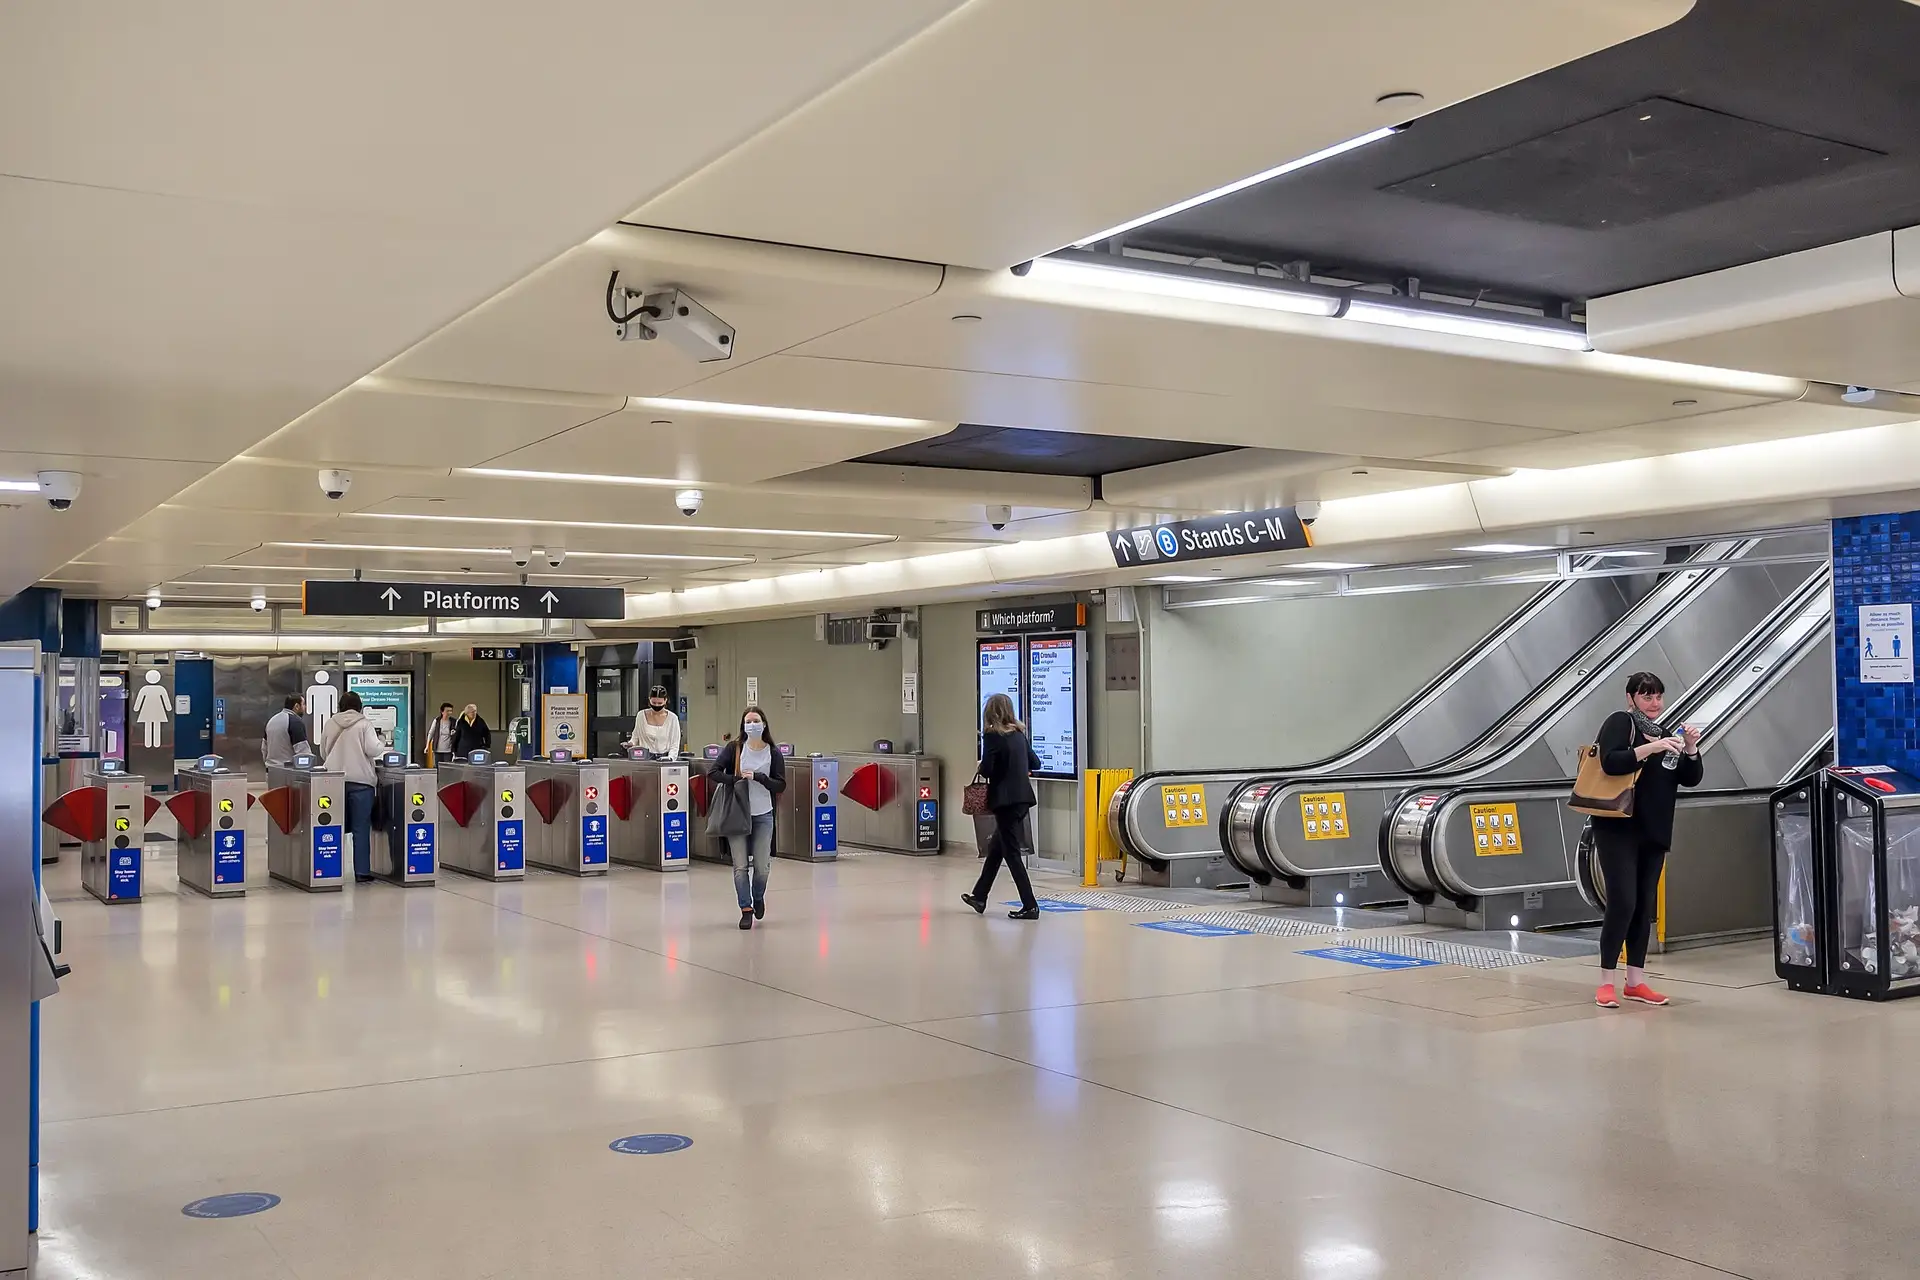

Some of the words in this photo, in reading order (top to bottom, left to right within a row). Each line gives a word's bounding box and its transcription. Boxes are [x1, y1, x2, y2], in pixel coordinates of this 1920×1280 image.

[1181, 522, 1245, 551] Stands
[1245, 516, 1287, 544] C-M
[423, 590, 520, 610] Platforms
[992, 612, 1016, 626] Which
[1016, 609, 1055, 627] platform?
[989, 653, 1000, 661] Bondi
[1040, 651, 1058, 659] Cronulla
[1014, 677, 1018, 686] 2
[1303, 795, 1326, 803] Caution!
[919, 835, 930, 843] gate
